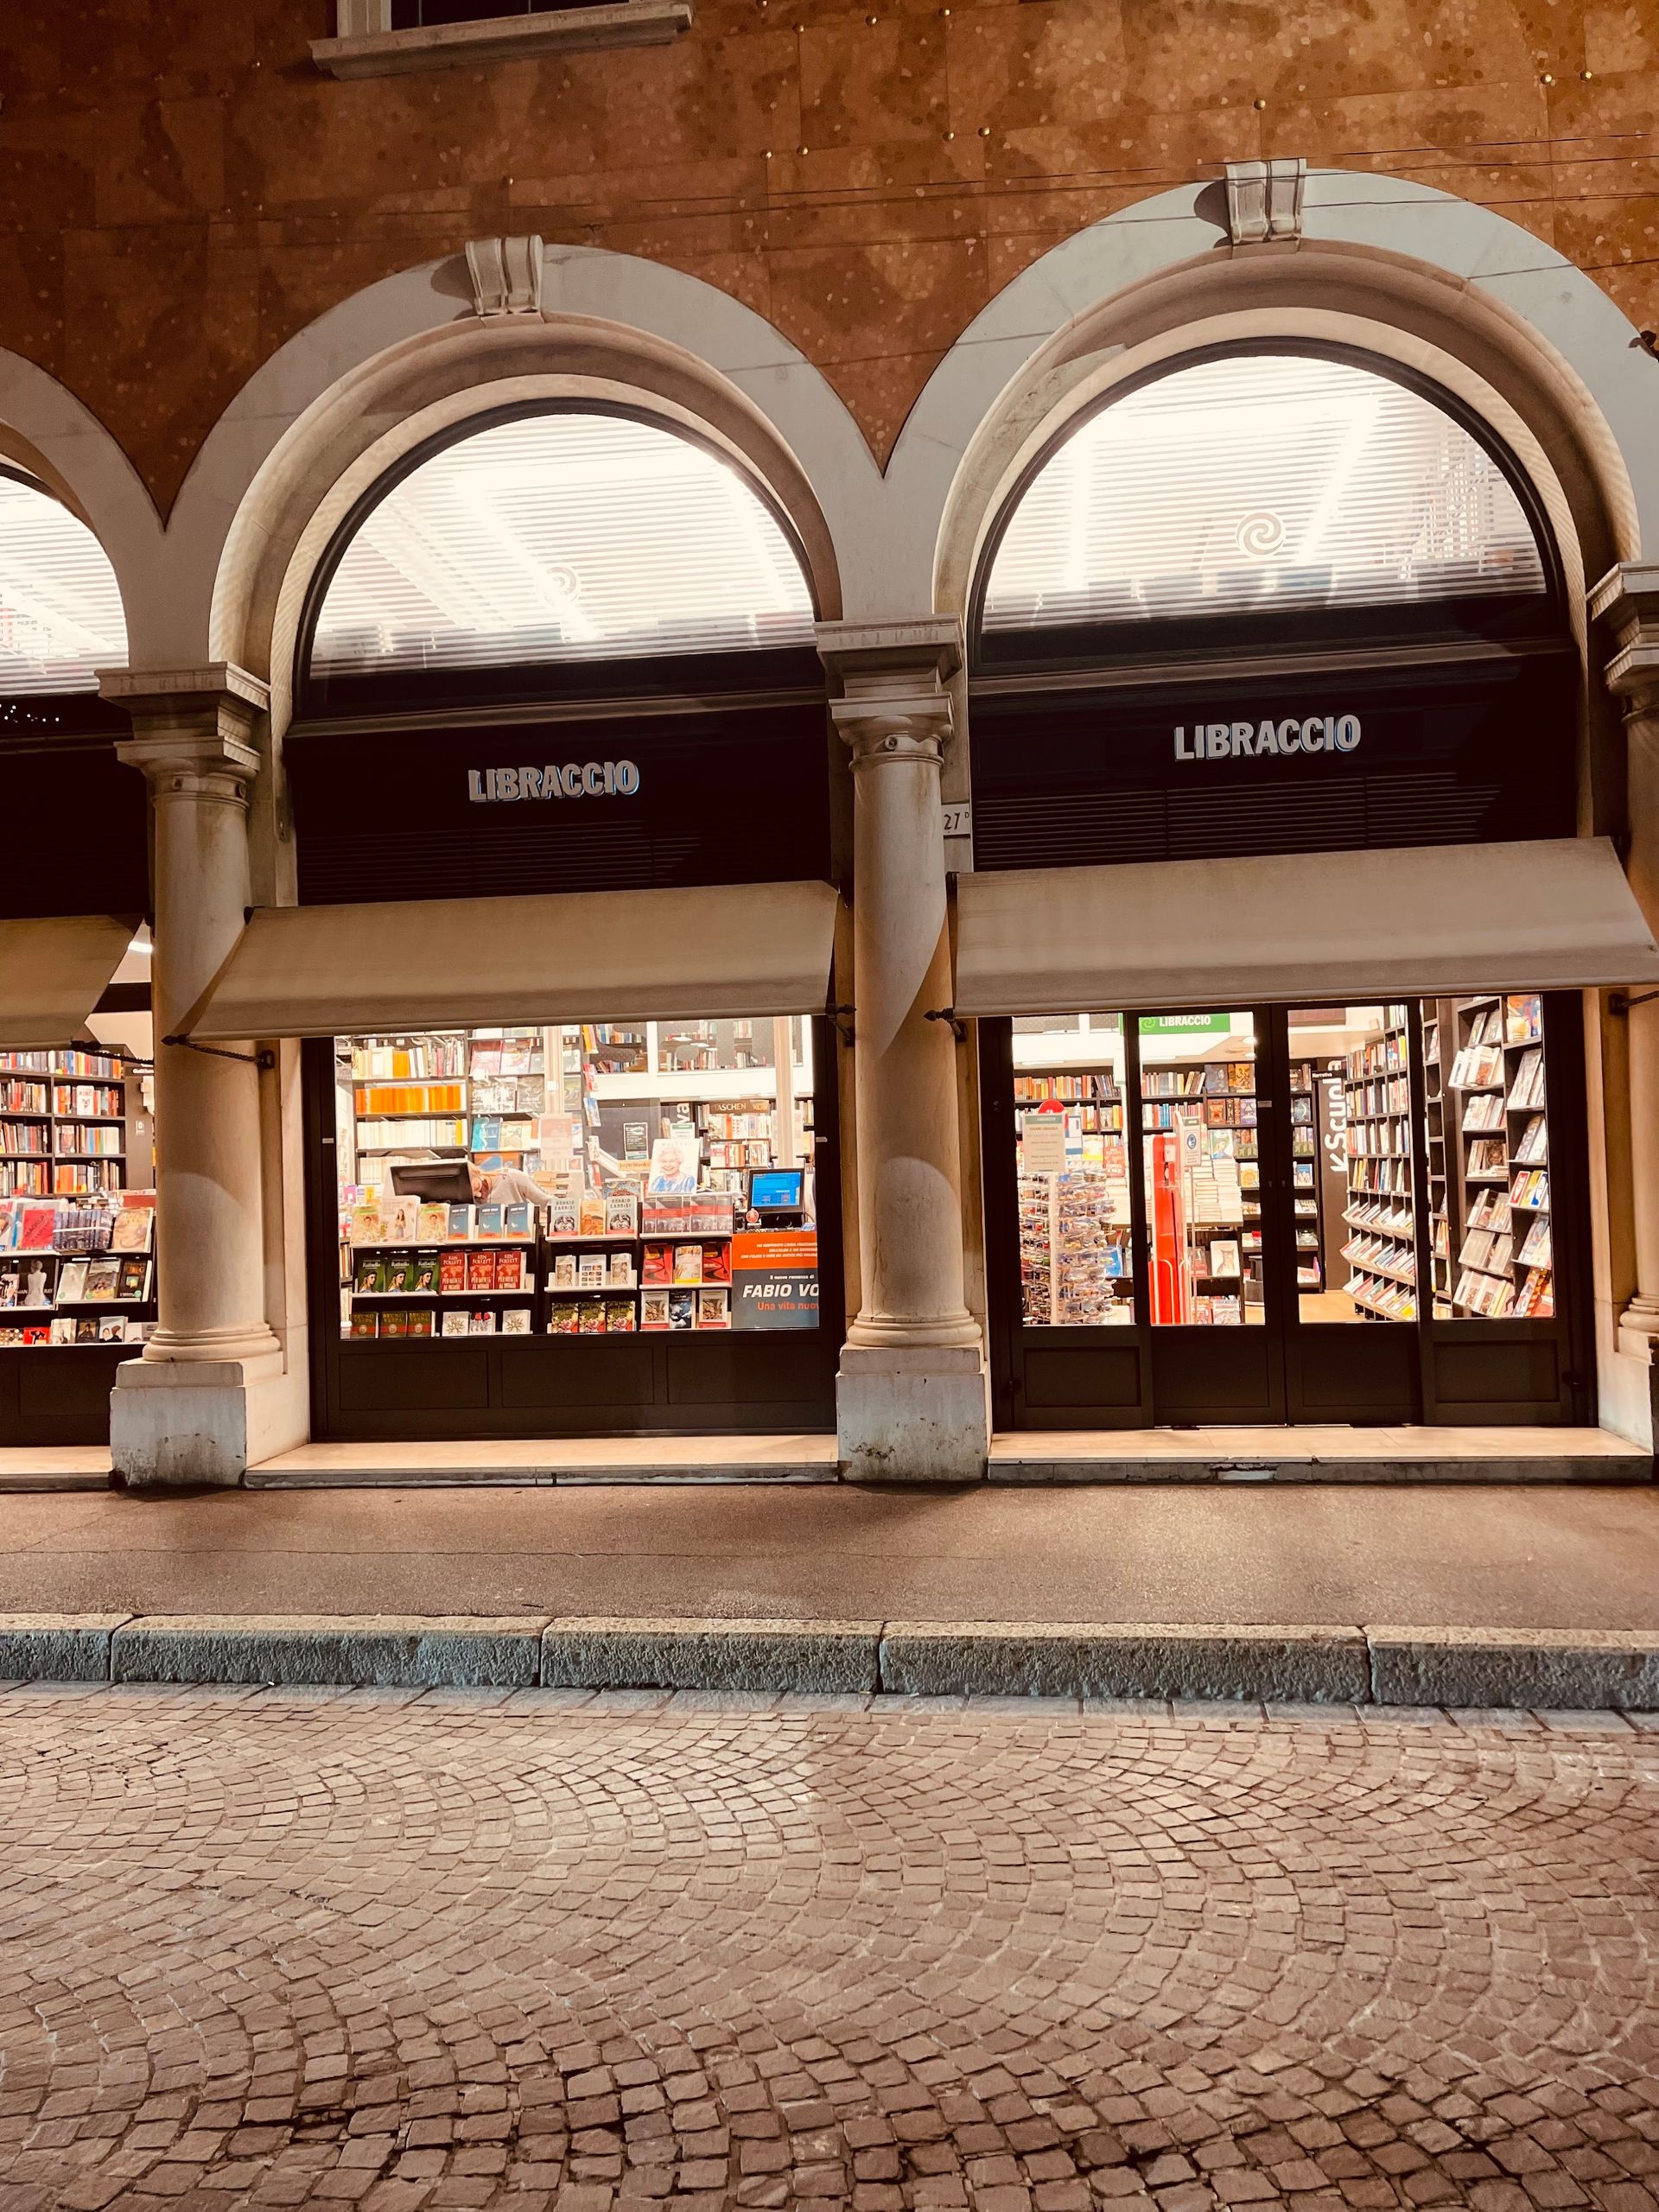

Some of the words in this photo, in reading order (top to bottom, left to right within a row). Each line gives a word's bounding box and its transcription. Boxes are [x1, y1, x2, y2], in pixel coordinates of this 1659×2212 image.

[1174, 714, 1361, 761] LIBRACCIO
[468, 760, 640, 803] LIBRACCIO
[1159, 1014, 1211, 1027] LIBRACCIO
[742, 1284, 792, 1298] FABIO
[757, 1301, 776, 1311] Una
[778, 1301, 795, 1310] vita
